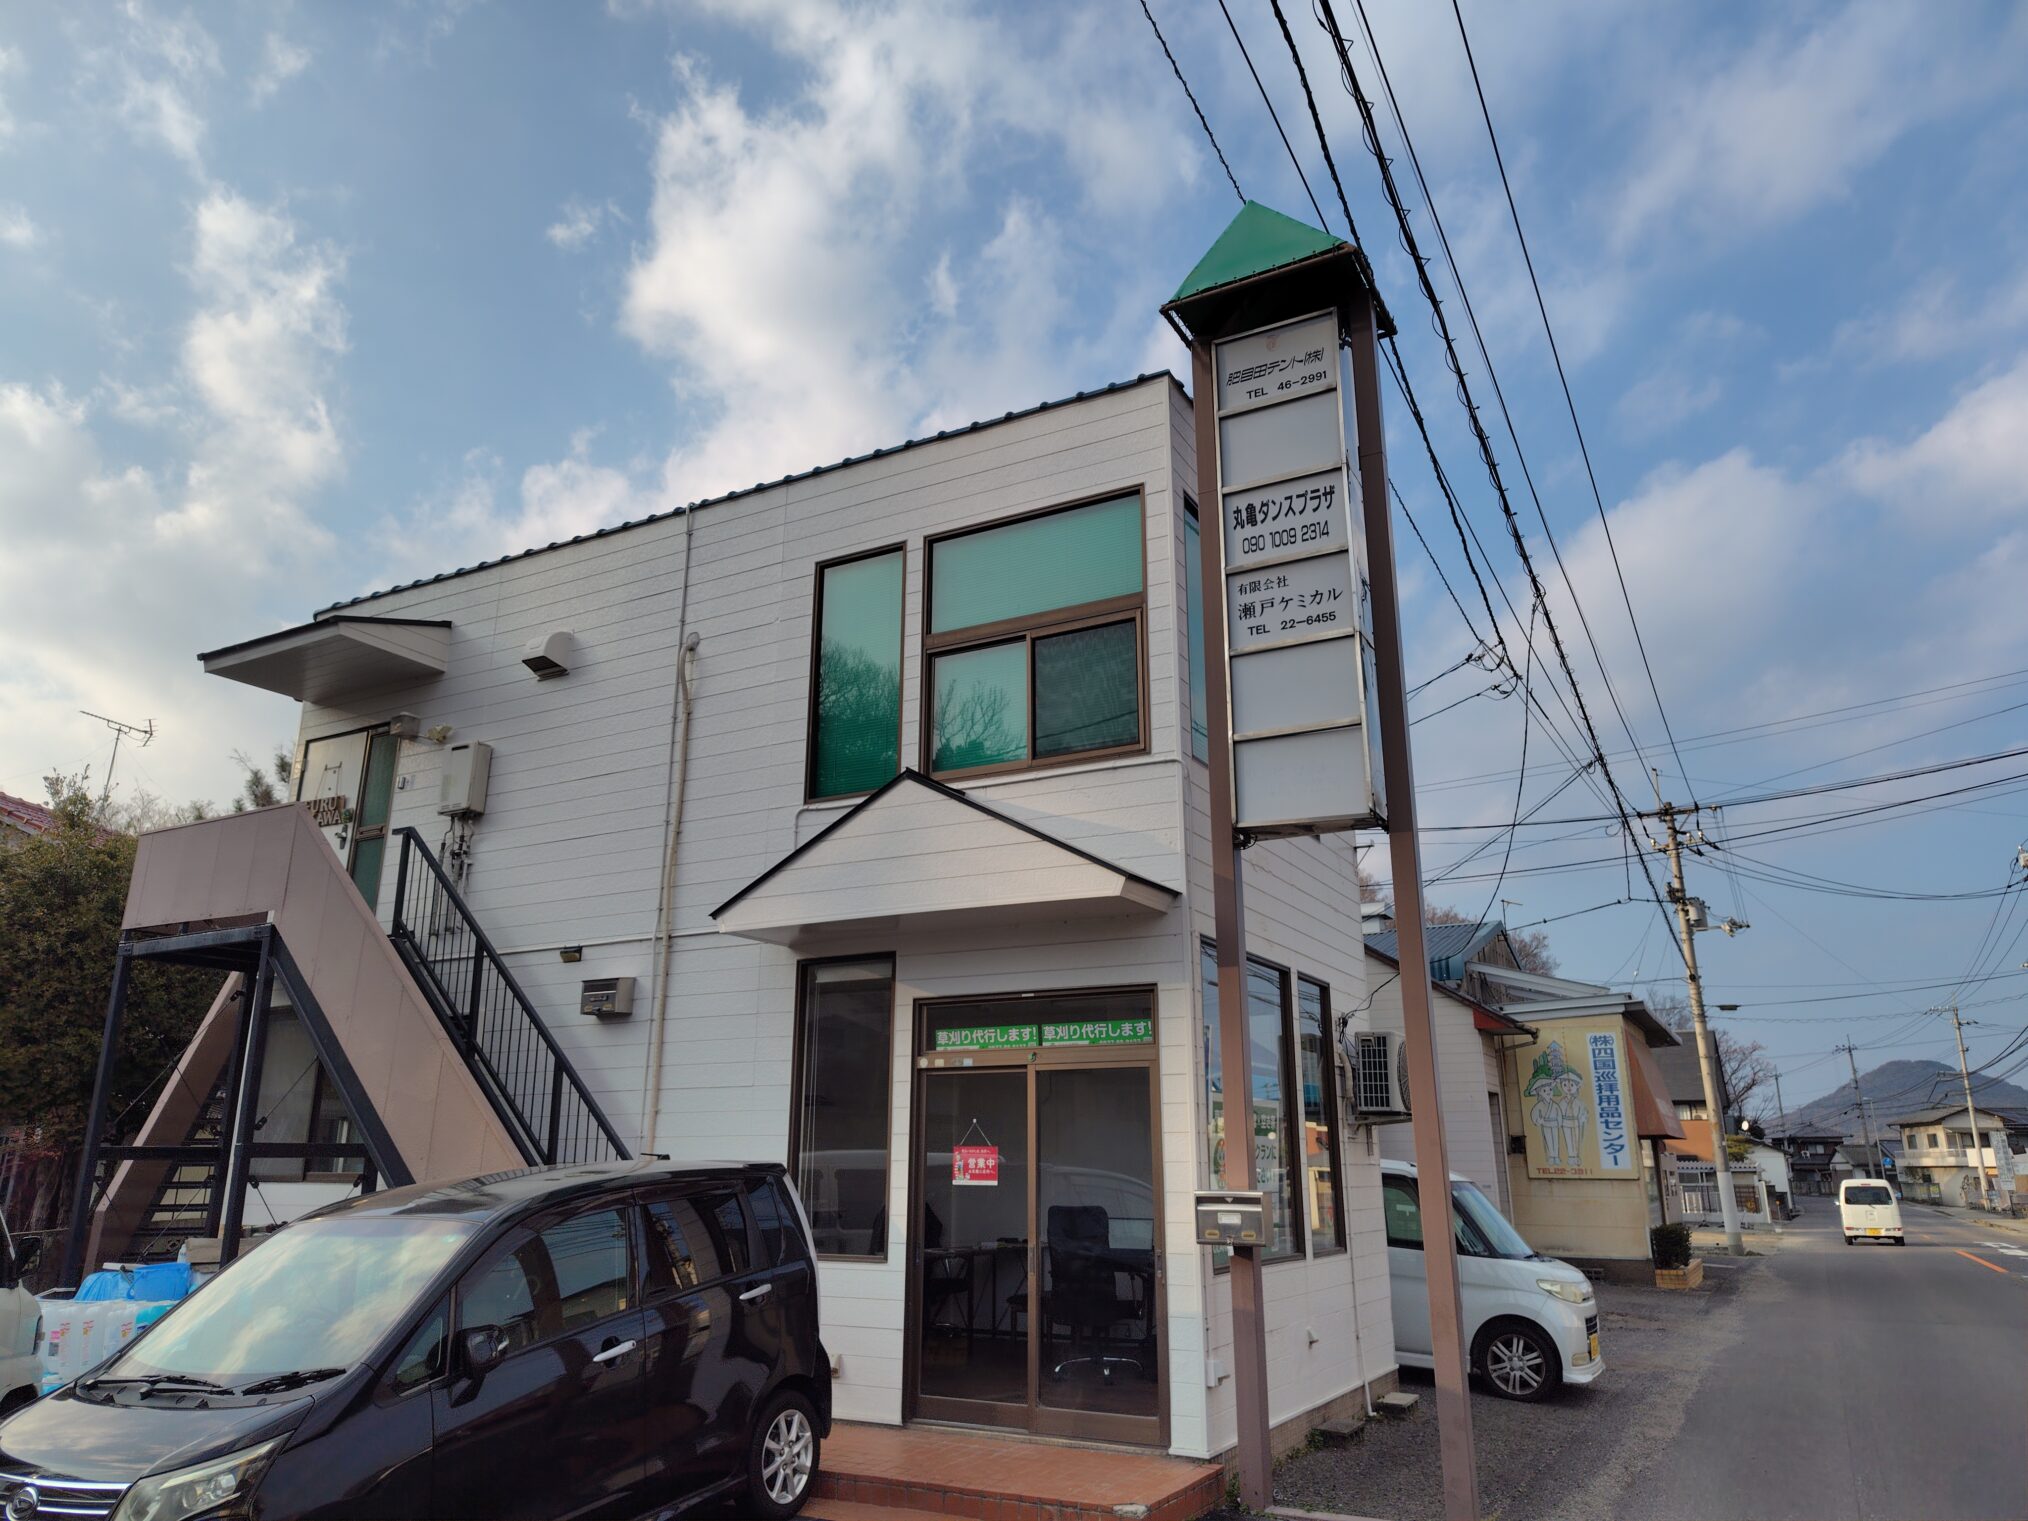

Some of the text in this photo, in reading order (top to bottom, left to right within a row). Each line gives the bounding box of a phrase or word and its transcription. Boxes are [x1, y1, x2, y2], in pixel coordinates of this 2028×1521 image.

[1246, 370, 1327, 400] TEL 46-2991
[1233, 484, 1335, 531] 丸亀ダンスプラザ
[1242, 520, 1330, 554] 090 1009 2314
[1238, 575, 1289, 596] 有限会社
[1238, 588, 1343, 621] 瀬戸ケミカル
[1248, 611, 1337, 636] TEL 22-6455
[937, 1026, 1037, 1045] 草刈り代行します!
[1043, 1021, 1152, 1040] 草刈り代行します!
[967, 1157, 995, 1169] 営業中
